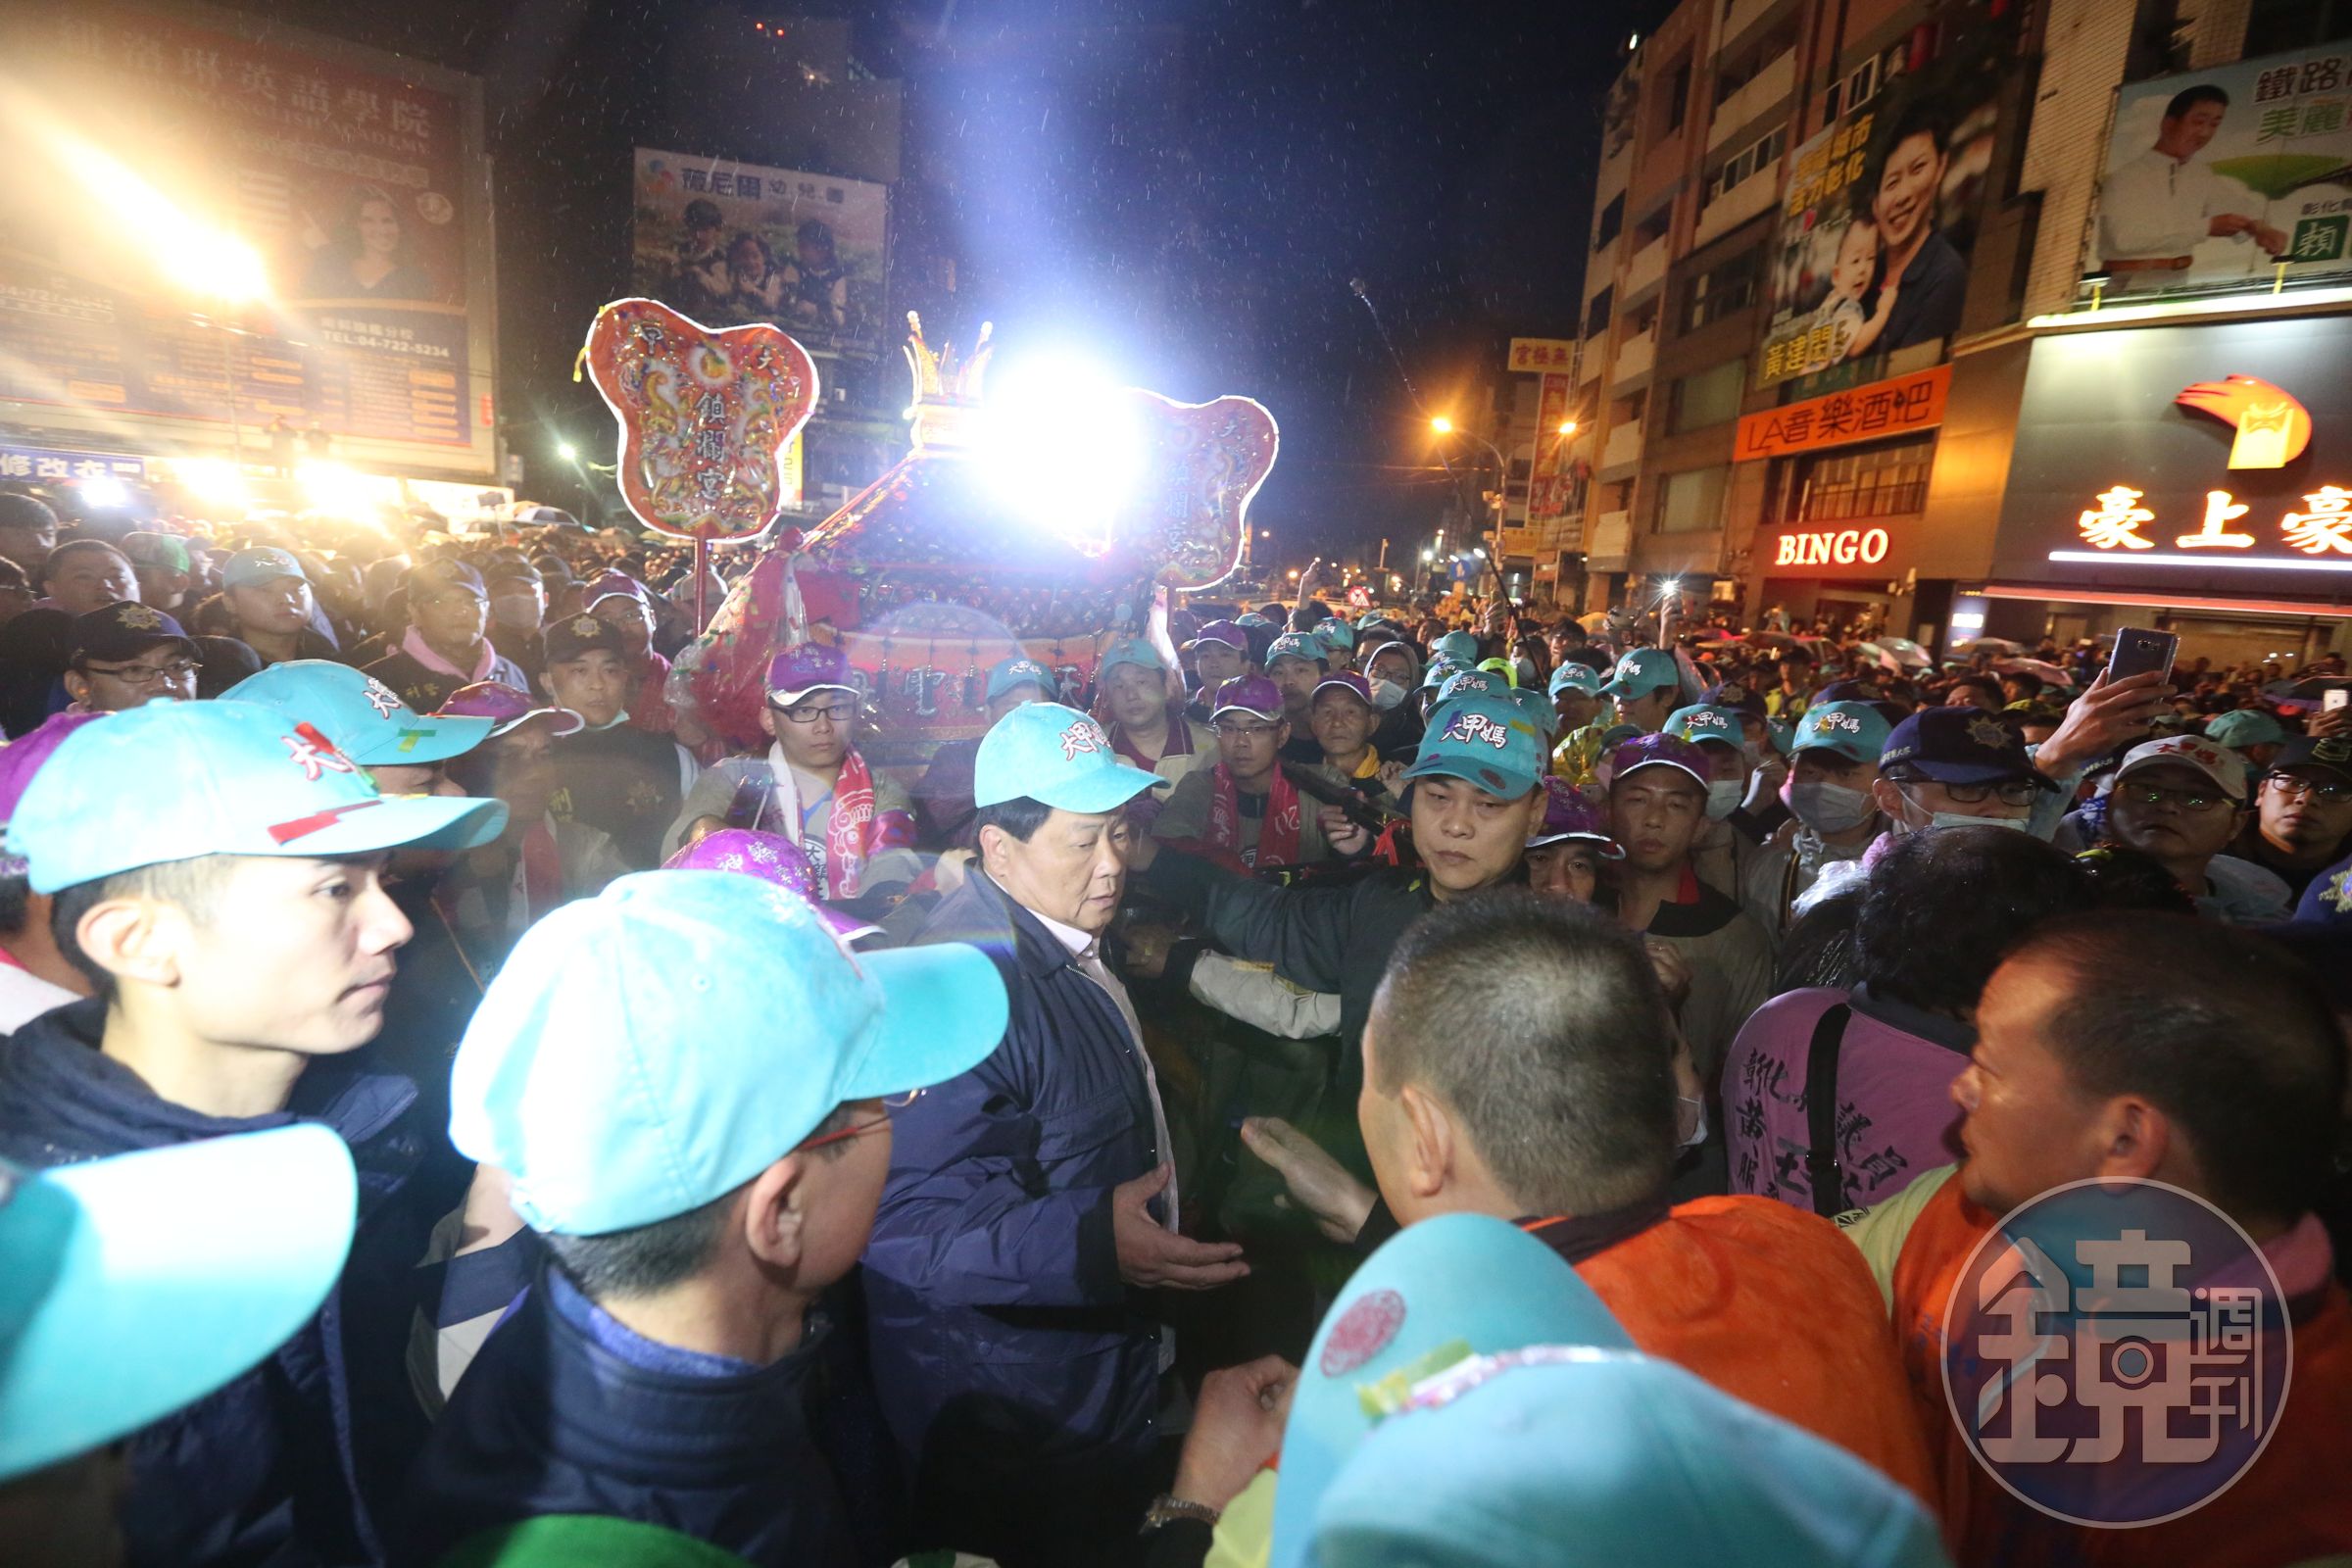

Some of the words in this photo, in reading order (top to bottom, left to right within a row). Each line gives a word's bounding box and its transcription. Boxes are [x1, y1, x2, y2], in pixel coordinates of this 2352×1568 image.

[2255, 57, 2352, 103] 鐵路
[2257, 102, 2352, 143] 美麗
[1775, 527, 1889, 566] BINGO
[1440, 712, 1508, 749] 大甲媽
